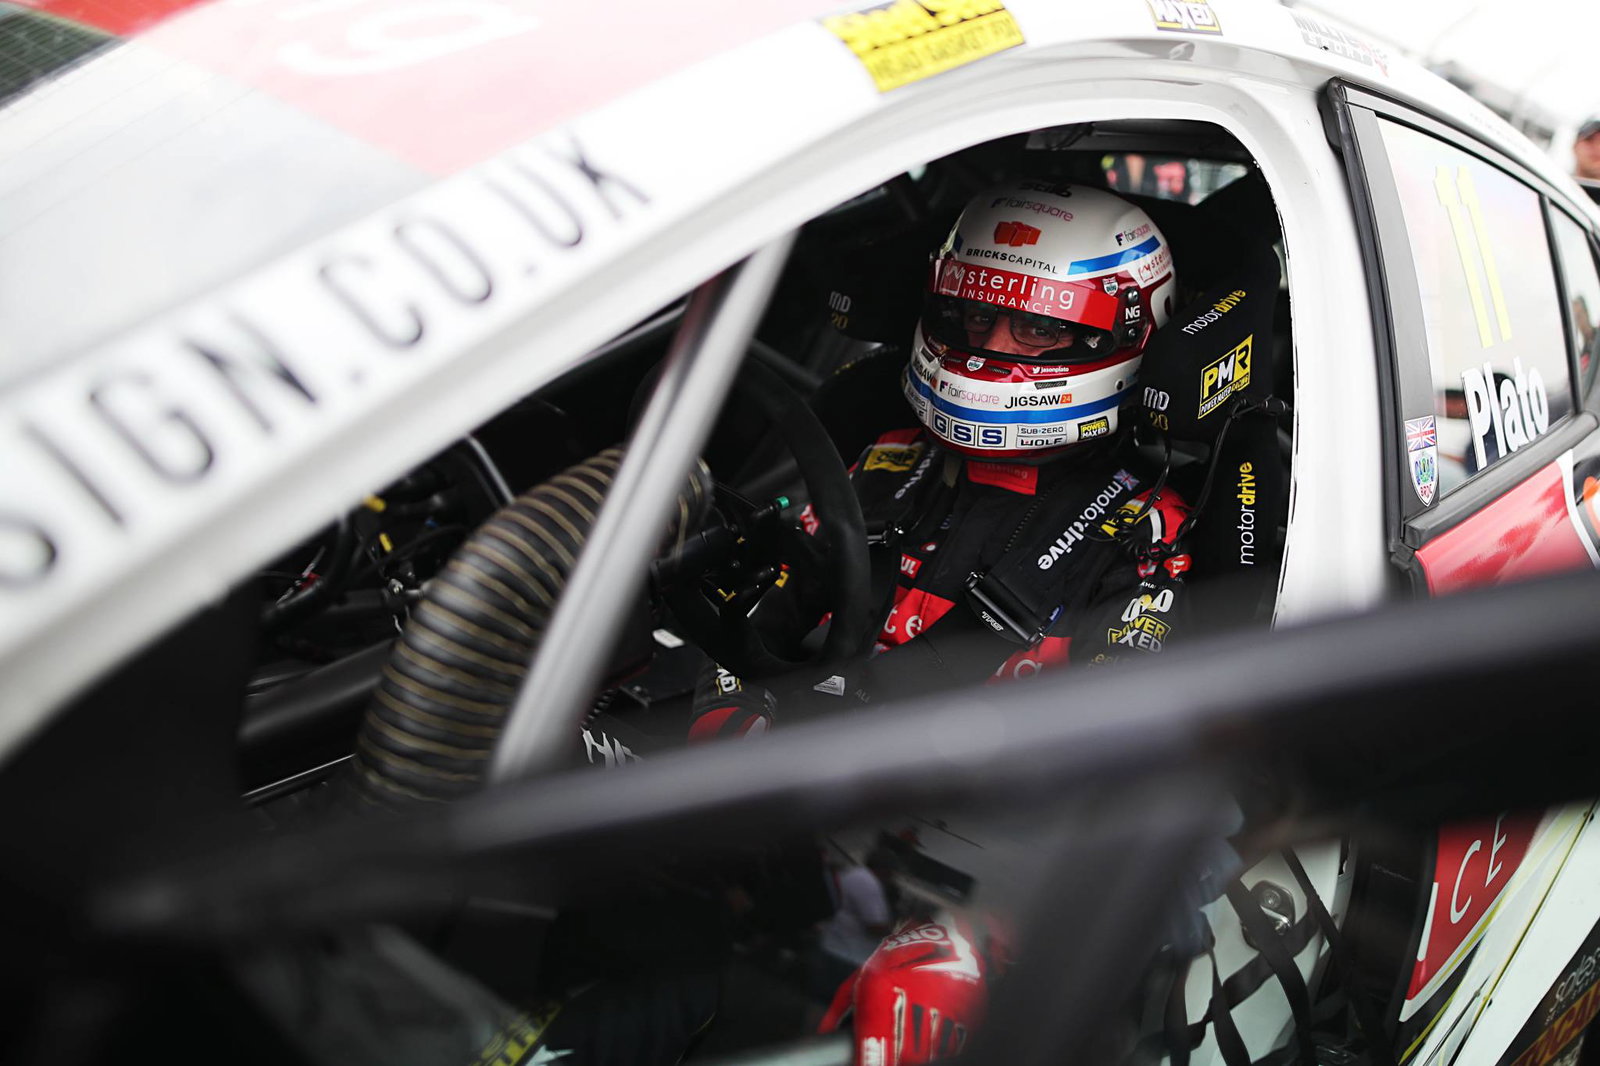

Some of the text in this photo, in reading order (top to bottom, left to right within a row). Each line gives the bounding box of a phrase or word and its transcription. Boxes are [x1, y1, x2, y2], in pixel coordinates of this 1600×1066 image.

[1005, 198, 1074, 221] fairsquare
[1434, 165, 1513, 348] 11
[962, 288, 1052, 315] INSURANCE
[966, 269, 1075, 310] sterling
[1181, 289, 1248, 335] motordrive
[1203, 344, 1250, 400] PMR
[947, 383, 1001, 404] fairsquare
[1004, 394, 1061, 409] JIGSAW
[1150, 412, 1169, 431] 20
[1462, 356, 1549, 471] Plato
[1081, 420, 1107, 433] POWER
[1082, 428, 1107, 439] MAXED
[1020, 438, 1063, 447] WOLF
[1235, 461, 1256, 565] motordrive
[1118, 629, 1163, 653] XED
